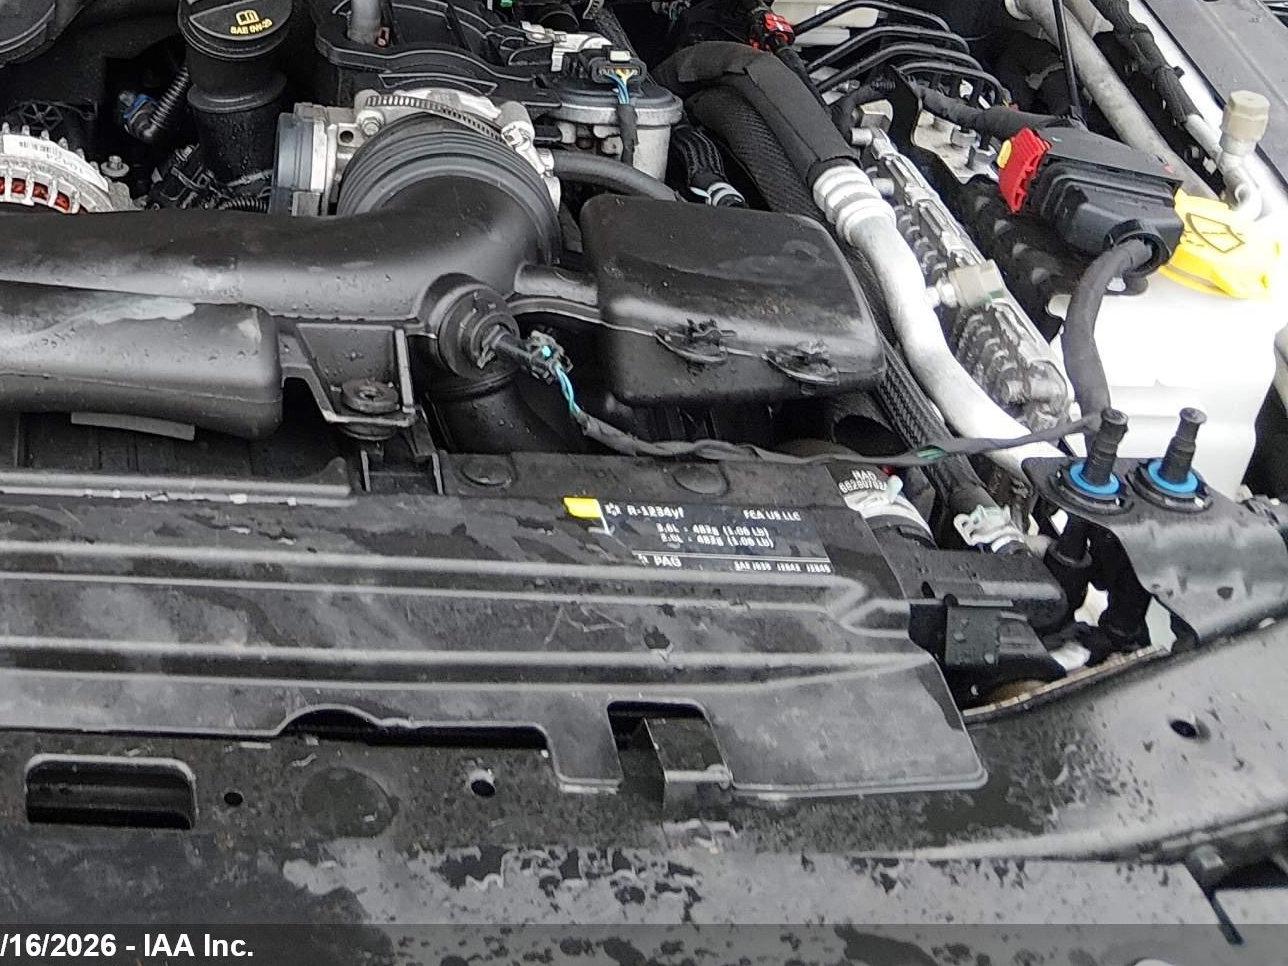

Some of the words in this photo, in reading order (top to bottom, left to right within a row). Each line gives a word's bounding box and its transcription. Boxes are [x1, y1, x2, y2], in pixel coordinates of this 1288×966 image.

[626, 503, 685, 520] R-1234yf
[743, 509, 766, 520] FCA
[765, 510, 782, 521] US
[782, 511, 802, 522] LLC
